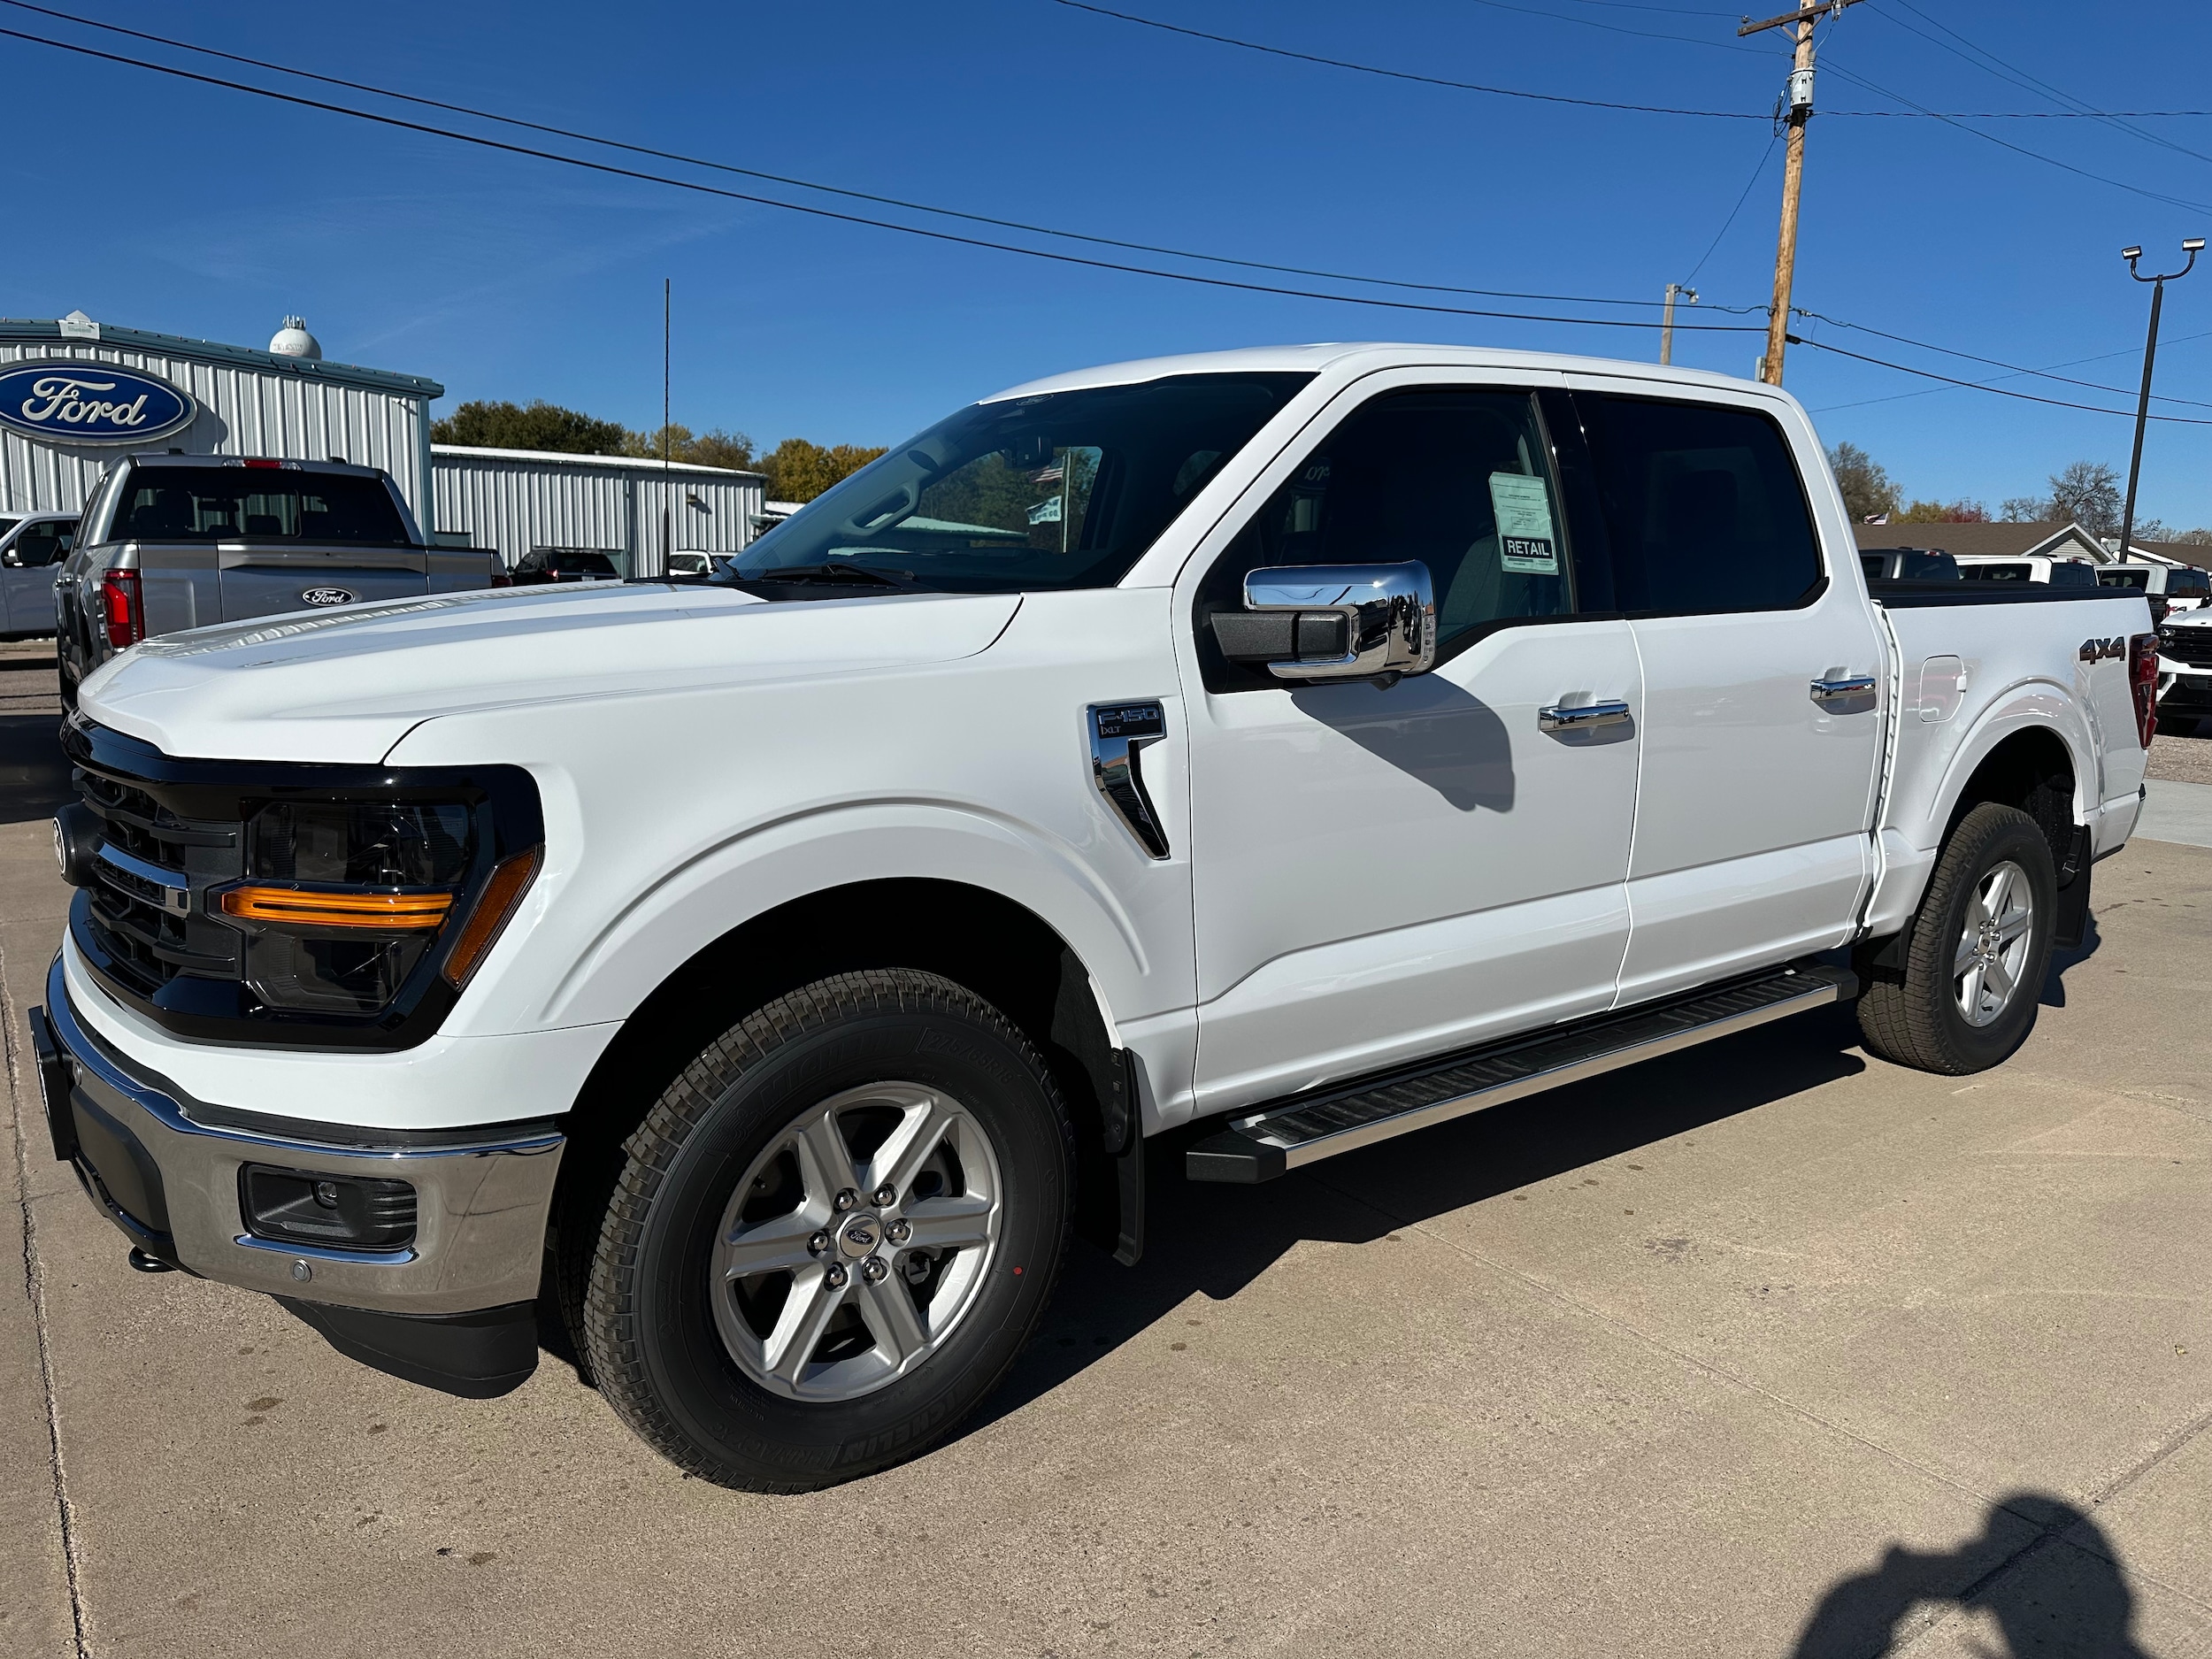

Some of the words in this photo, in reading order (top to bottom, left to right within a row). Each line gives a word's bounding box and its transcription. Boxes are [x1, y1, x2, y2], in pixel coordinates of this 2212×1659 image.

[21, 376, 149, 426] Ford
[1506, 539, 1550, 557] RETAIL
[311, 590, 345, 603] Ford
[1098, 707, 1160, 726] F-150
[1103, 726, 1121, 735] XLT
[849, 1230, 871, 1243] Ford
